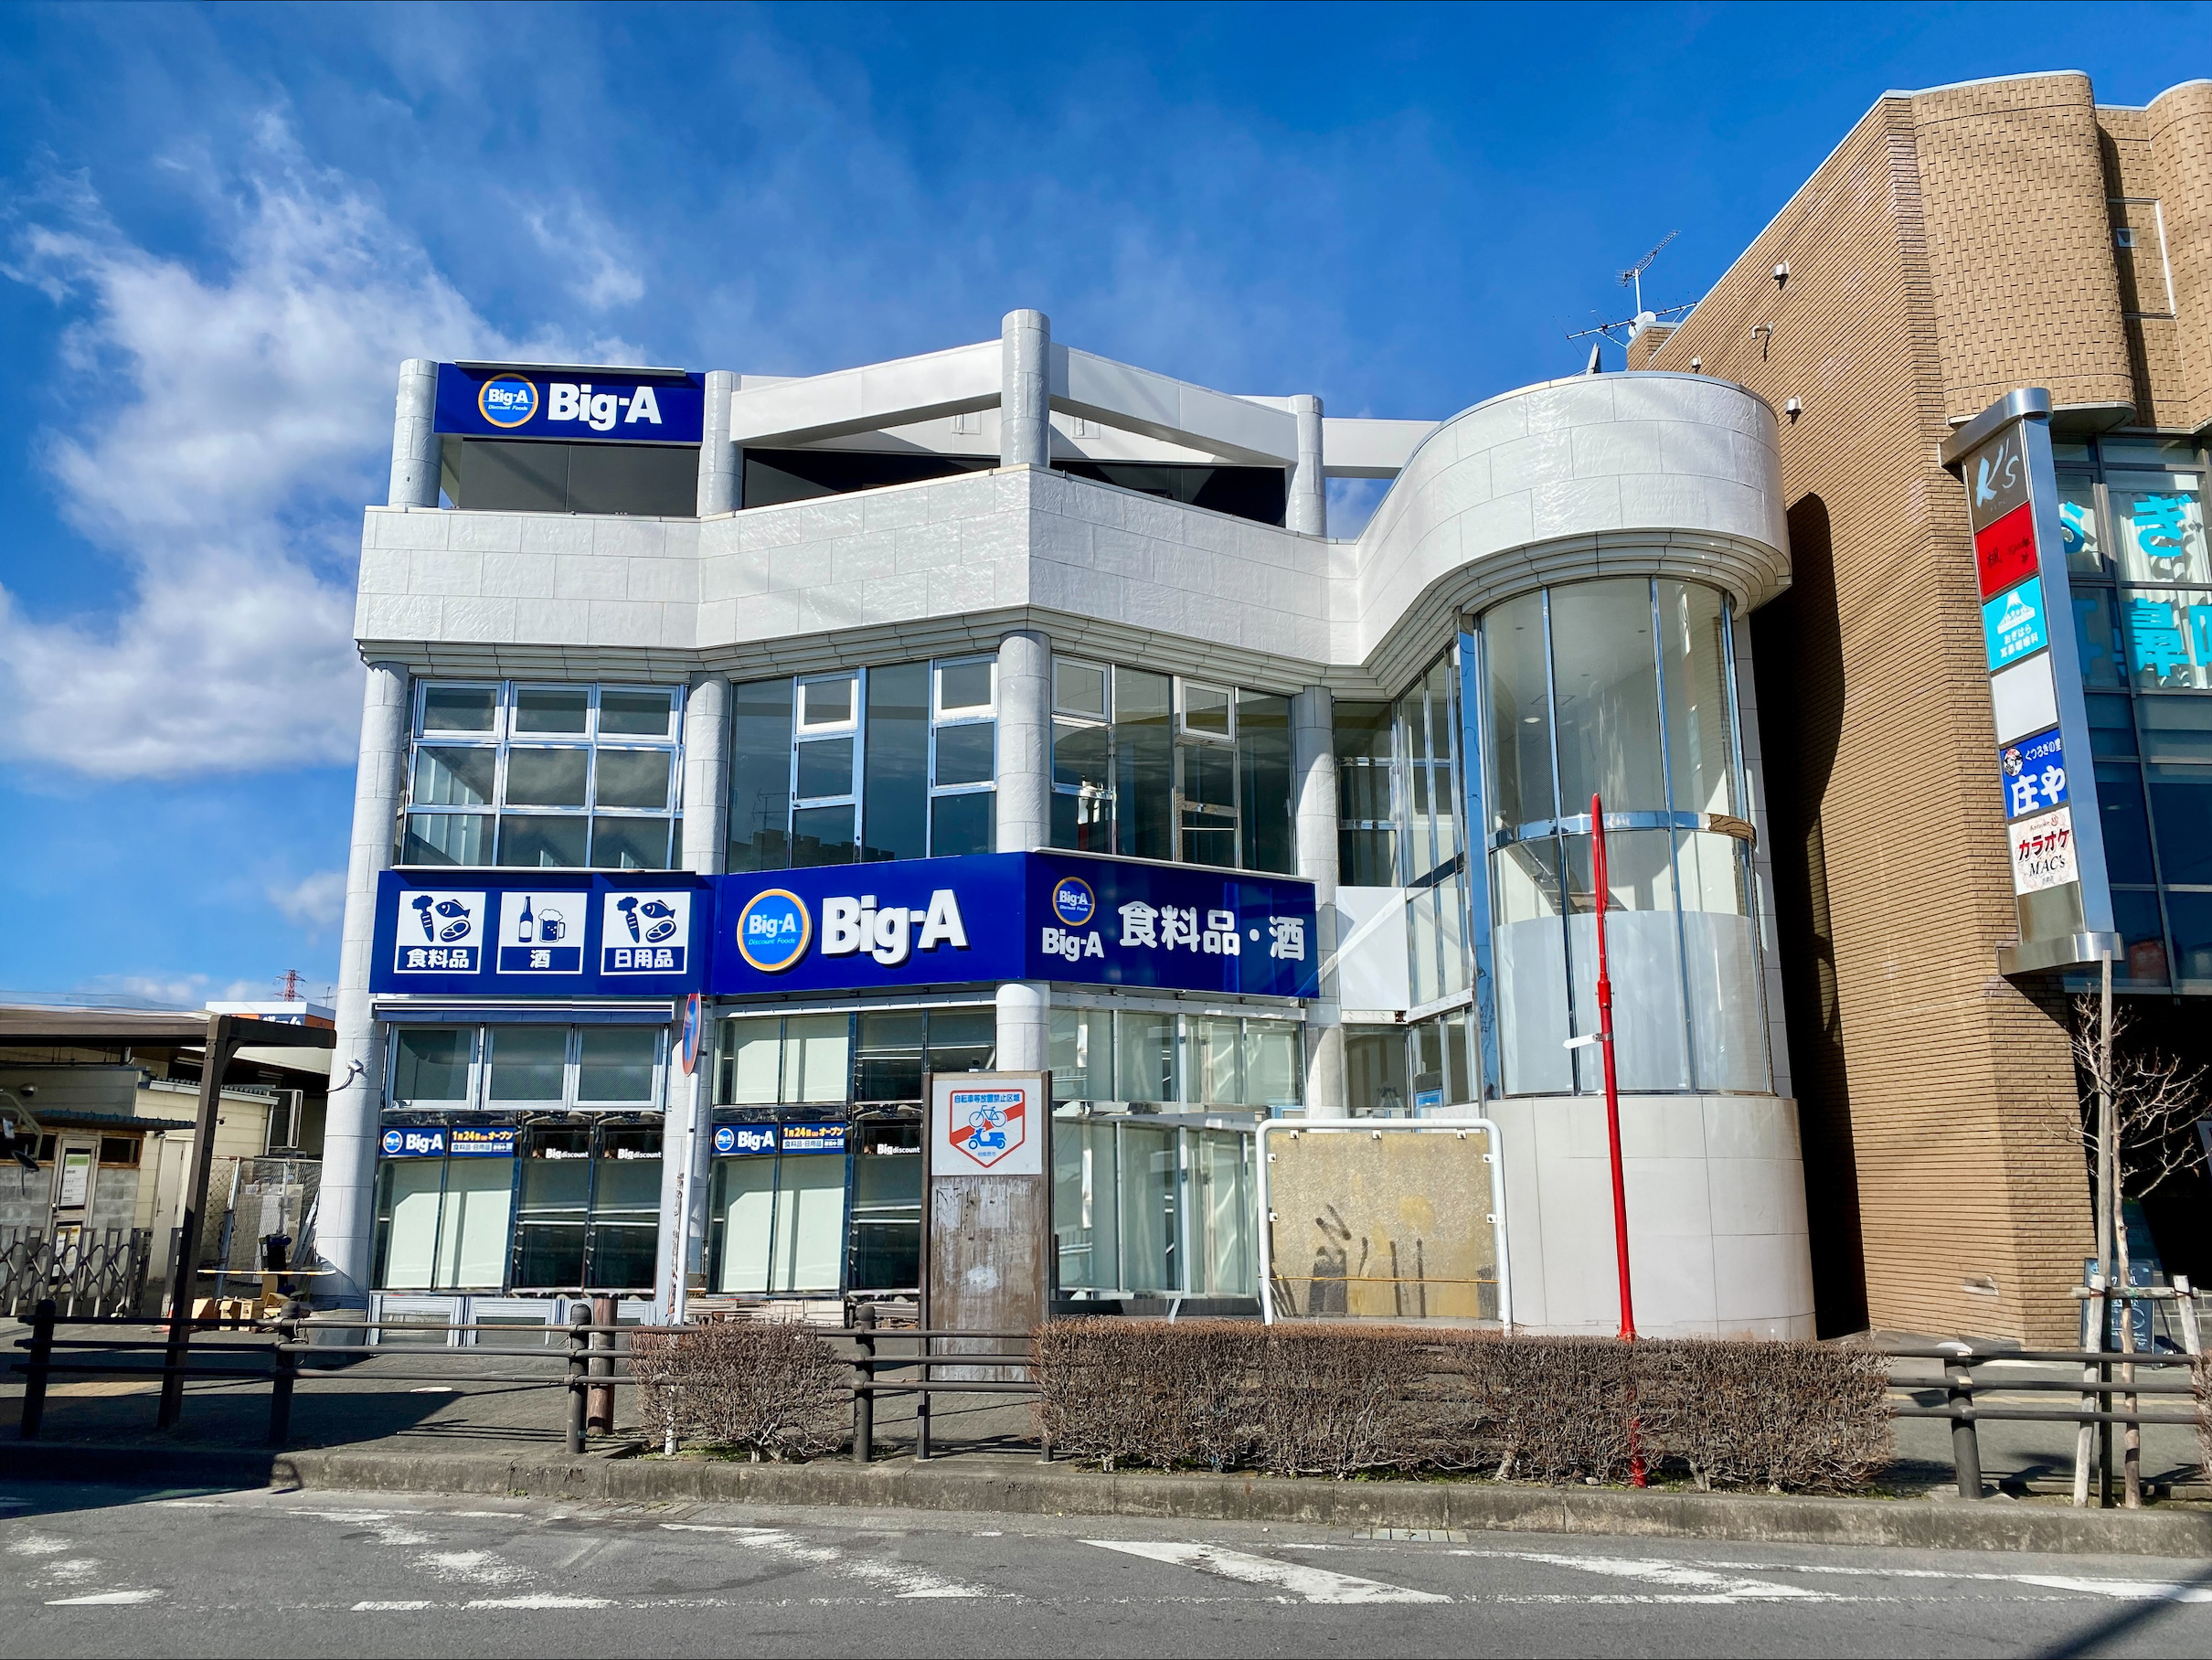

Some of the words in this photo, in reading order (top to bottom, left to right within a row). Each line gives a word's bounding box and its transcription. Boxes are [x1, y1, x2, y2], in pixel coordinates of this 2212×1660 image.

[488, 388, 528, 405] Big-A
[548, 382, 663, 431] Big-A
[1976, 438, 2020, 508] K's
[2011, 765, 2067, 817] 庄や
[2018, 828, 2070, 862] カラオケ
[1059, 890, 1088, 907] Big-A
[749, 913, 796, 938] Big-A
[821, 889, 969, 964] Big-A
[1117, 900, 1305, 962] 食料品・酒
[748, 937, 775, 946] Discount
[777, 937, 796, 945] Foods
[1042, 927, 1104, 963] Big-A
[406, 948, 470, 969] 食料品
[529, 949, 550, 969] 酒
[614, 949, 675, 969] 日用品
[954, 1093, 1021, 1103] 自転車等放置禁止区域
[406, 1133, 443, 1154] Big-A
[738, 1131, 775, 1151] Big-A
